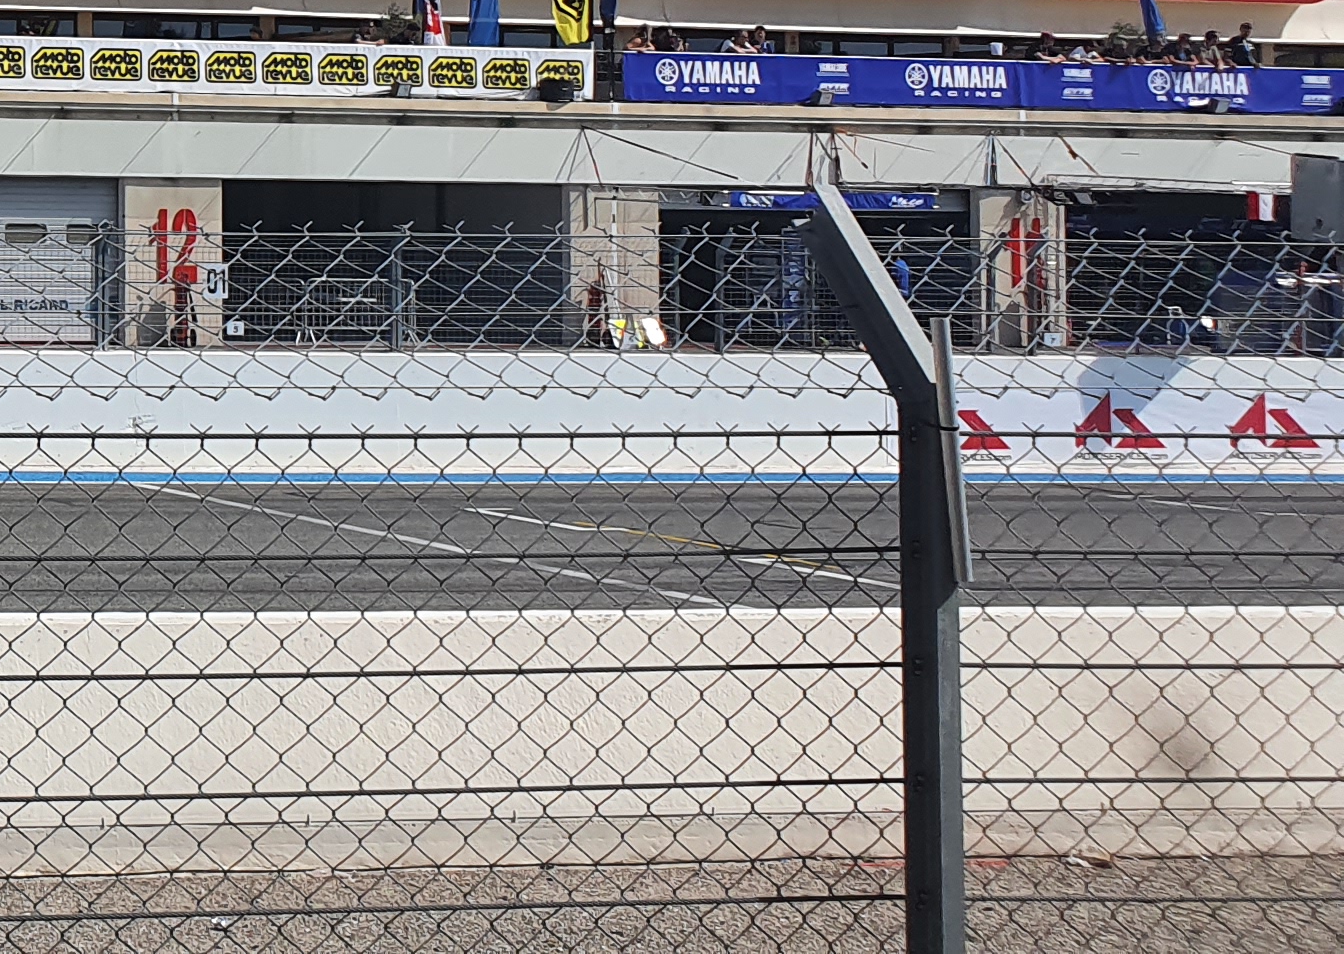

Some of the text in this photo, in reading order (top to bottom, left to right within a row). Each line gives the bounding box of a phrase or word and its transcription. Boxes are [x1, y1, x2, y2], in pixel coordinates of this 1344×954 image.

[34, 48, 81, 63] Moto
[92, 50, 140, 65] Moto
[150, 51, 197, 66] Moto
[208, 53, 254, 68] Moto
[265, 54, 309, 69] Moto
[34, 63, 82, 77] revue
[320, 56, 366, 70] Moto
[376, 57, 420, 71] Moto
[431, 59, 475, 73] Moto
[484, 61, 529, 74] Moto
[538, 62, 582, 76] Moto
[92, 65, 140, 78] revue
[150, 66, 197, 80] revue
[208, 68, 254, 81] revue
[265, 69, 310, 82] revue
[321, 70, 366, 83] revue
[678, 60, 762, 85] YAMAHA
[928, 64, 1009, 89] YAMAHA
[431, 72, 475, 86] revue
[484, 73, 529, 88] revue
[1171, 70, 1249, 96] YAMAHA
[665, 85, 757, 95] RACING
[913, 88, 1003, 98] RACING
[149, 208, 198, 284] 12
[206, 268, 226, 294] 01
[13, 299, 69, 311] RICARD
